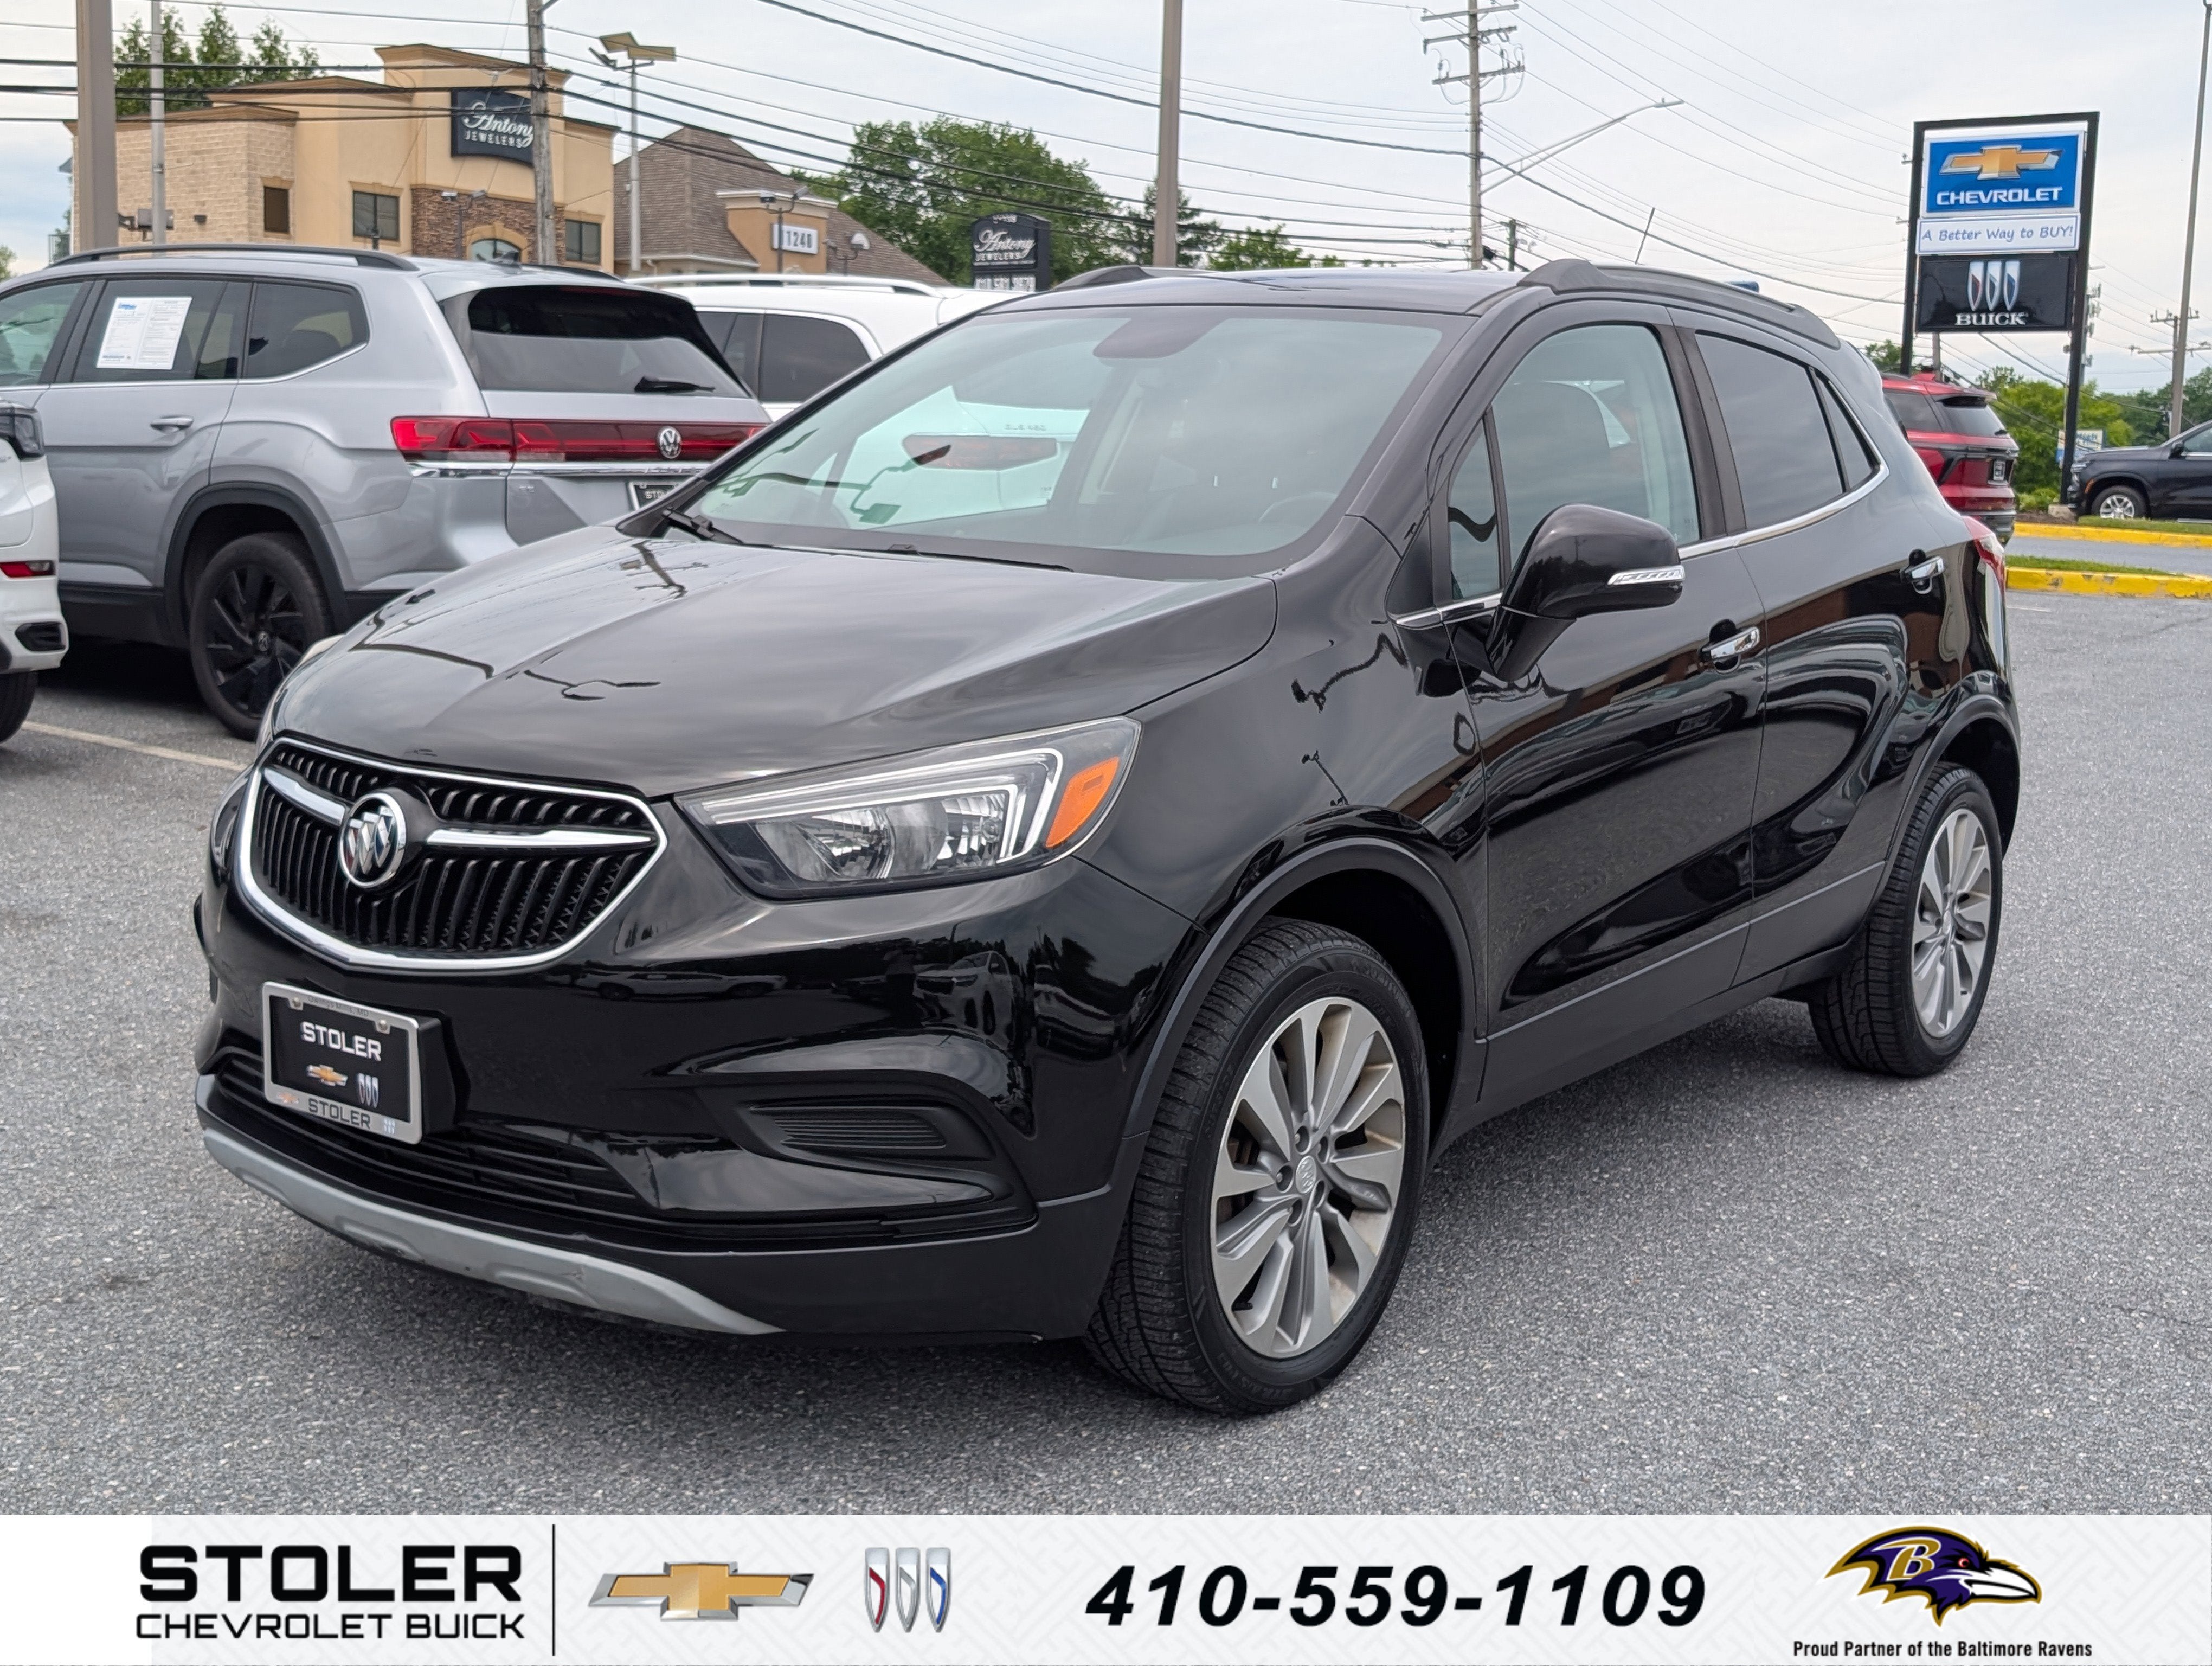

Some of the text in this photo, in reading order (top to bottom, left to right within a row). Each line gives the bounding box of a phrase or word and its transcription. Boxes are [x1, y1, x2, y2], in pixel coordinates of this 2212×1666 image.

[465, 131, 522, 148] JEWELERS
[1937, 187, 2063, 205] CHEVROLET
[1922, 225, 2073, 242] A Better Way to BUY!
[1954, 312, 2029, 326] BUICK
[300, 1021, 382, 1061] STOLER
[308, 1098, 371, 1130] STOLER
